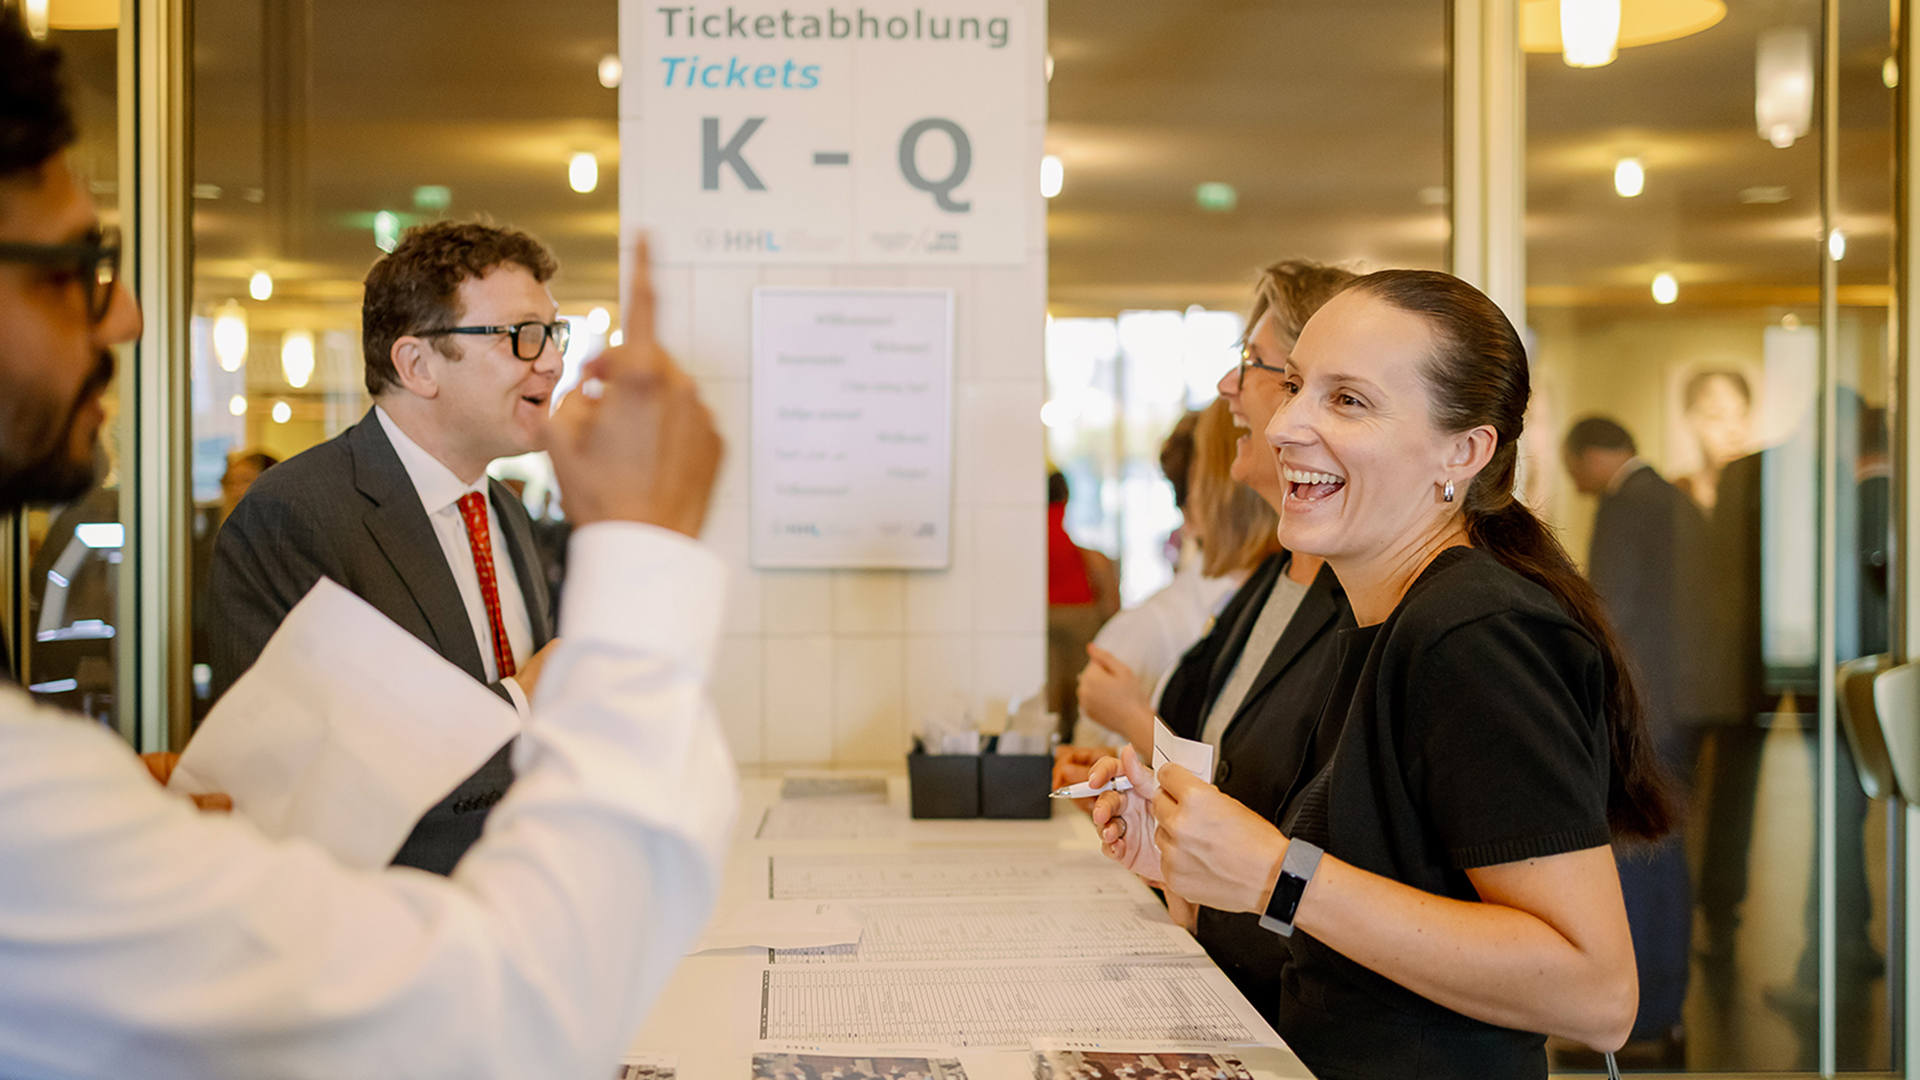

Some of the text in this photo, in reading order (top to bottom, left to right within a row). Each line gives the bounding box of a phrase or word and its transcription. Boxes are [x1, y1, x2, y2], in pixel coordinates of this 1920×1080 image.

[658, 6, 1010, 48] Ticketabholung
[661, 56, 820, 89] Tickets
[702, 117, 972, 213] K - Q
[724, 230, 781, 251] HHL
